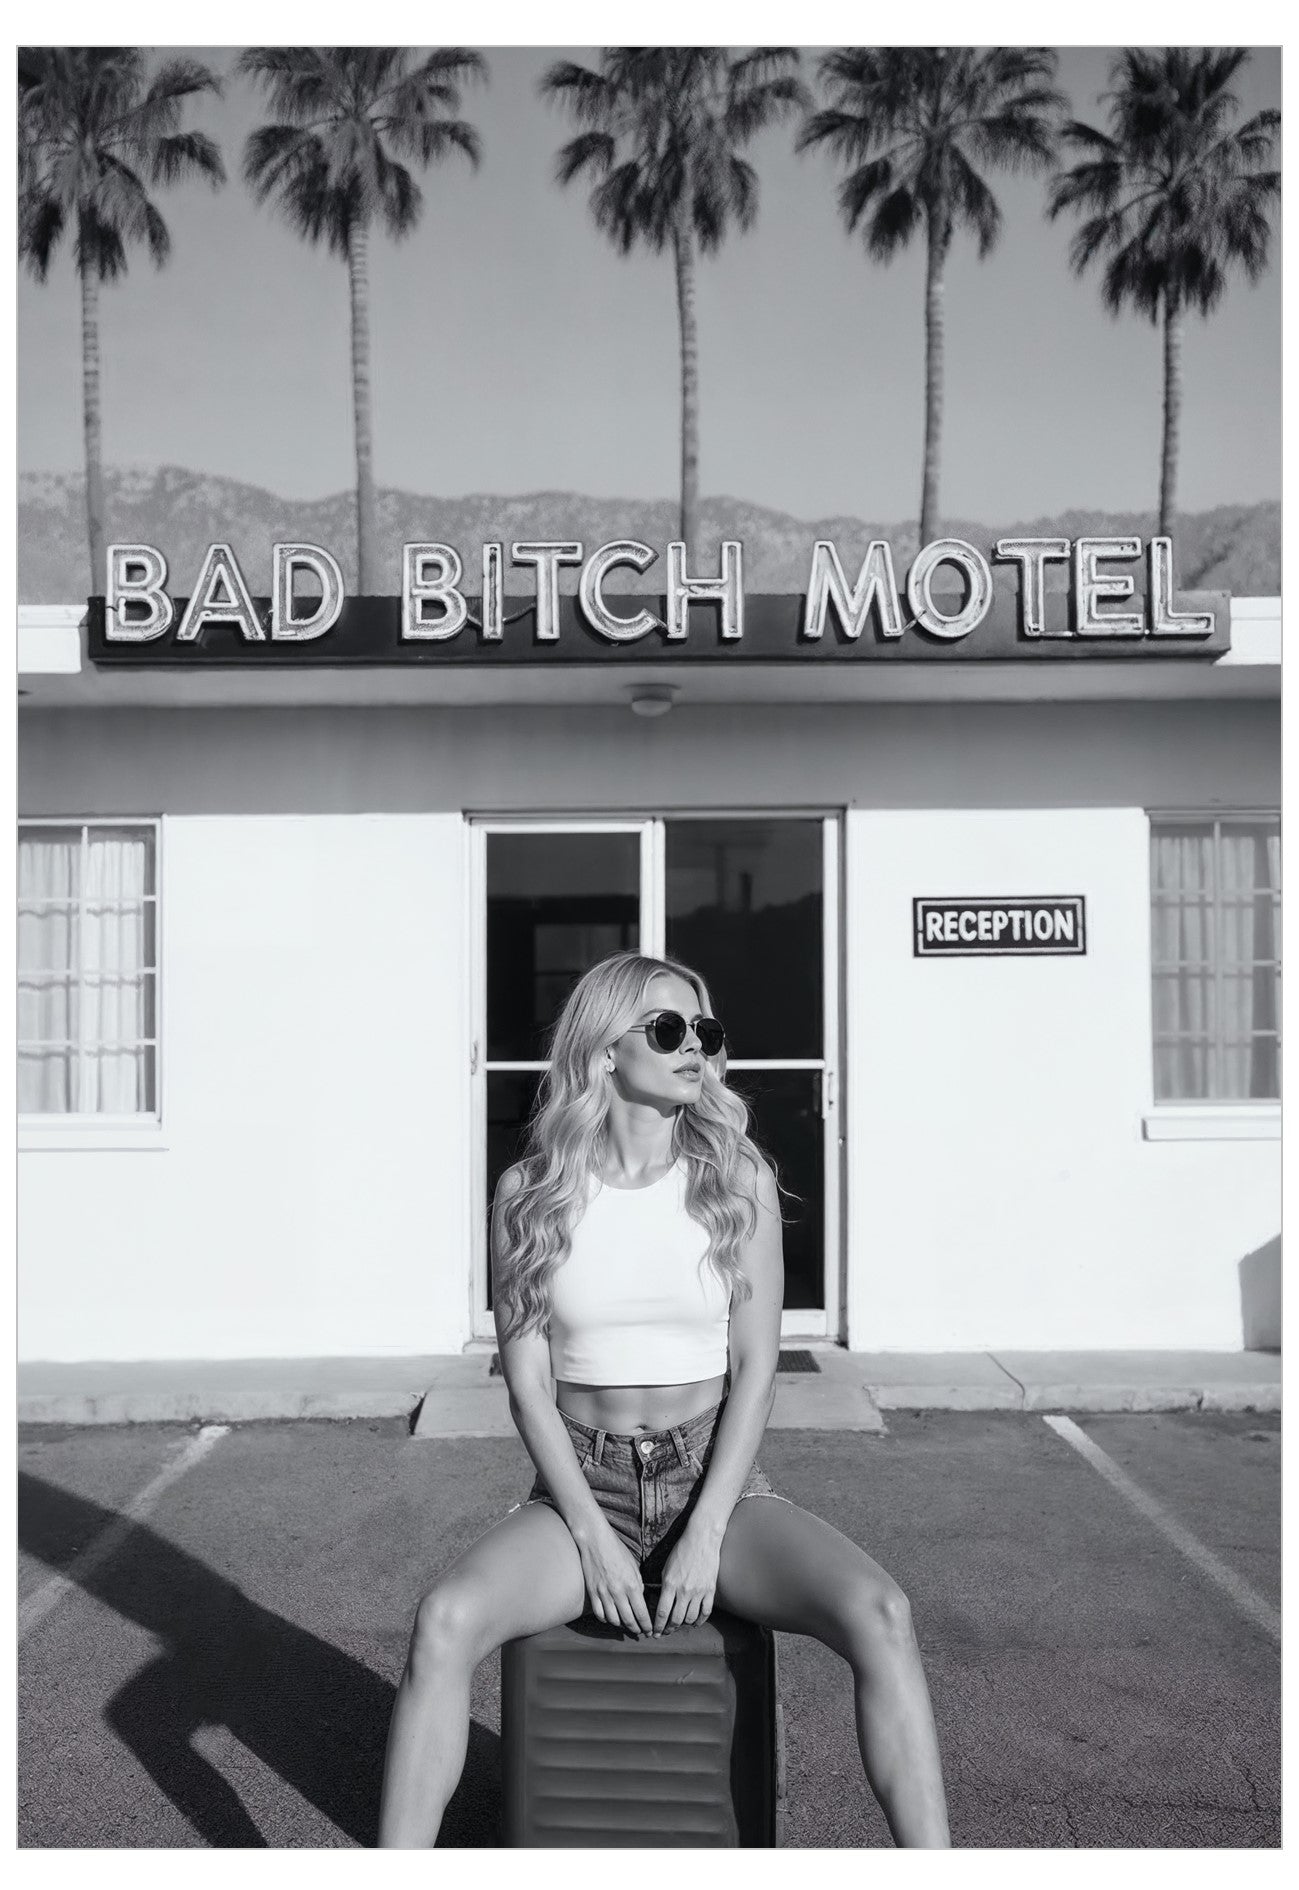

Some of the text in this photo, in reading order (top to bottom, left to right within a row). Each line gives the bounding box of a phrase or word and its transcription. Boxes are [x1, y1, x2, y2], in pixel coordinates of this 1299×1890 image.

[105, 536, 1216, 642] BAD BITCH MOTEL
[925, 909, 1074, 942] RECEPTION
